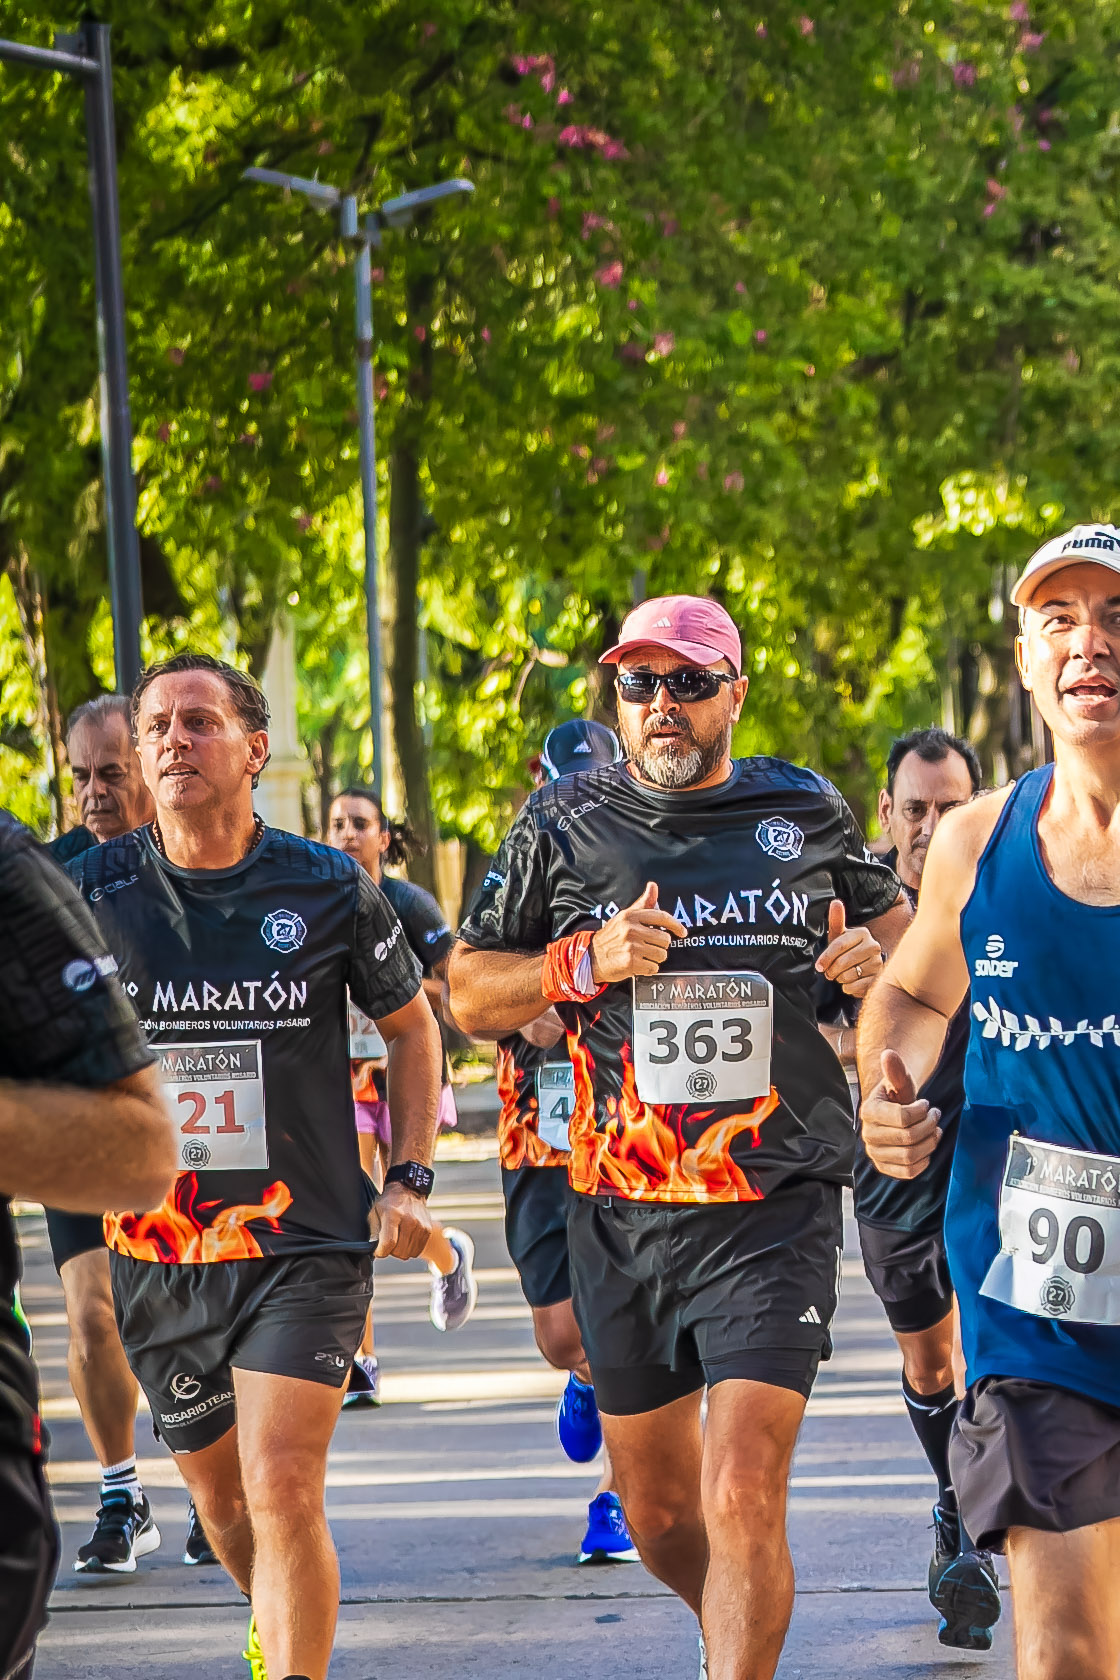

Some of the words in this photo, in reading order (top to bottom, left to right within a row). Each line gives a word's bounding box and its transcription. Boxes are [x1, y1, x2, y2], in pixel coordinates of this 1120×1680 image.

[1061, 537, 1114, 554] PUMA
[654, 878, 809, 928] ARATÓN
[707, 934, 780, 946] VOLUNTARIOS
[152, 970, 307, 1012] MARATÓN
[669, 977, 752, 1000] MARATÓN
[158, 1019, 211, 1031] BOMBEROS
[212, 1019, 274, 1030] VOLUNTARIOS
[648, 1018, 754, 1065] 363
[161, 1049, 241, 1072] MARATÓN
[177, 1089, 245, 1135] 21
[1028, 1207, 1106, 1275] 90
[1048, 1287, 1065, 1301] 27
[160, 1402, 208, 1424] ROSARIO
